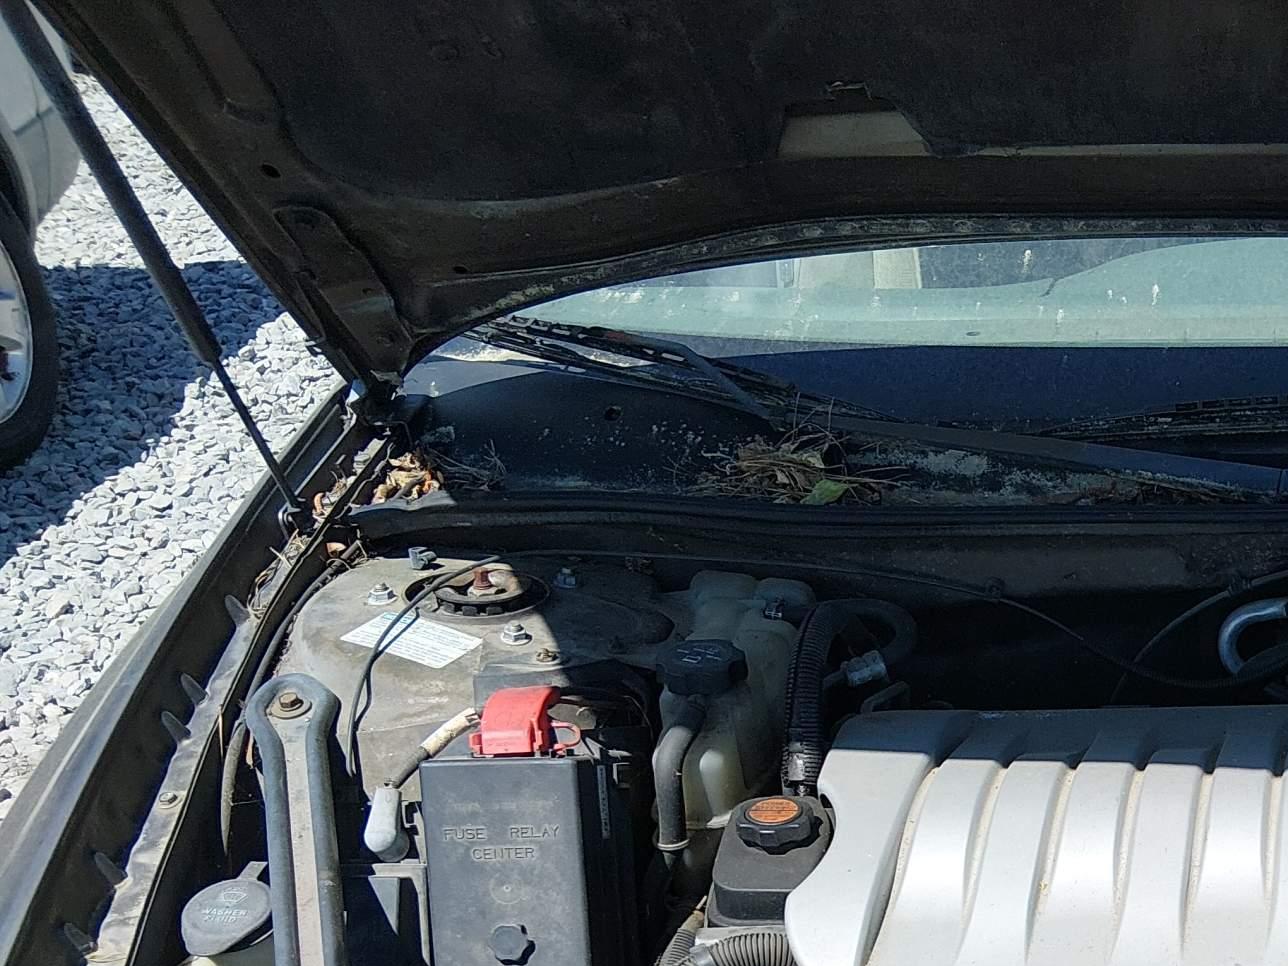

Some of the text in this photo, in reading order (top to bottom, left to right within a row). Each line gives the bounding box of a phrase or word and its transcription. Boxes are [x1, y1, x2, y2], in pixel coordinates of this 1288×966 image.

[443, 825, 560, 841] FUSE RELAY
[472, 847, 535, 860] CENTER
[201, 907, 248, 917] WASHER
